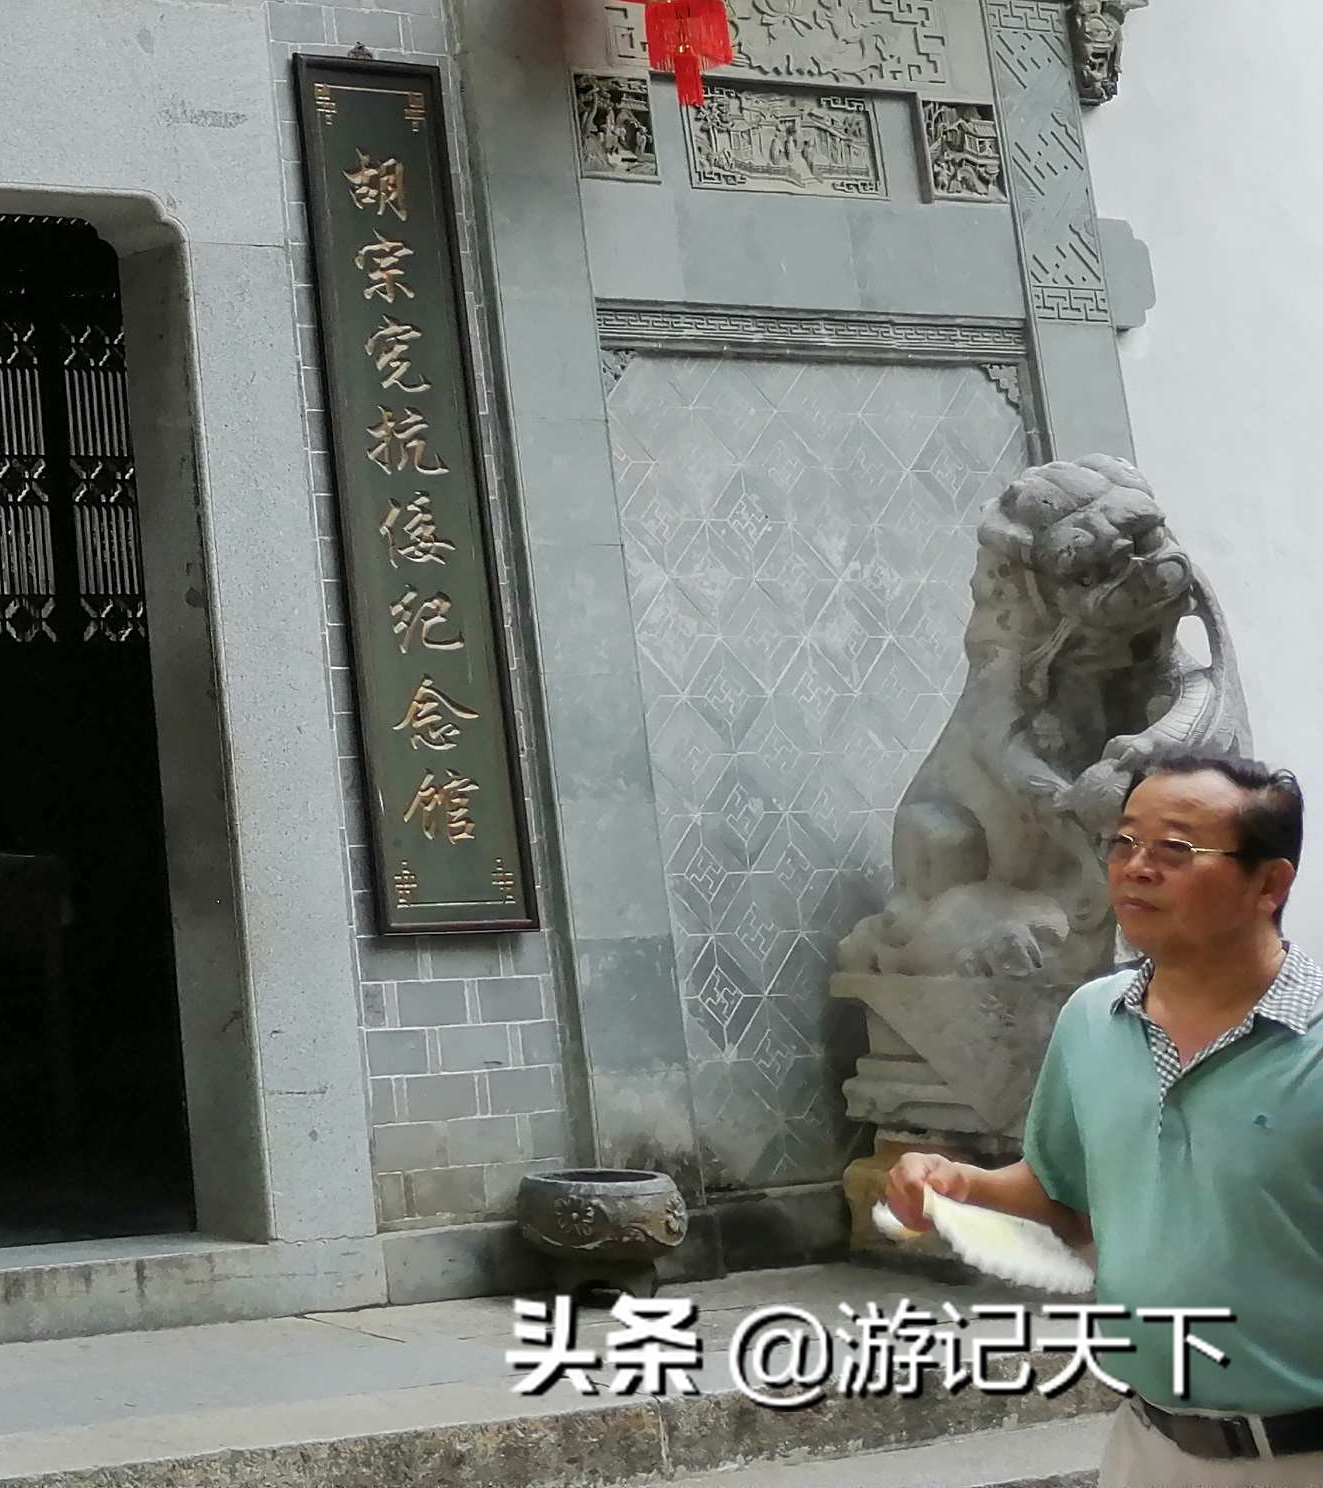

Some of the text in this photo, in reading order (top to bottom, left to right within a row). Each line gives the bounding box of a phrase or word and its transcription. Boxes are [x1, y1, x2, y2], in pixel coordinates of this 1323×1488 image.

[341, 147, 480, 845] 胡宗宪抗倭纪念馆
